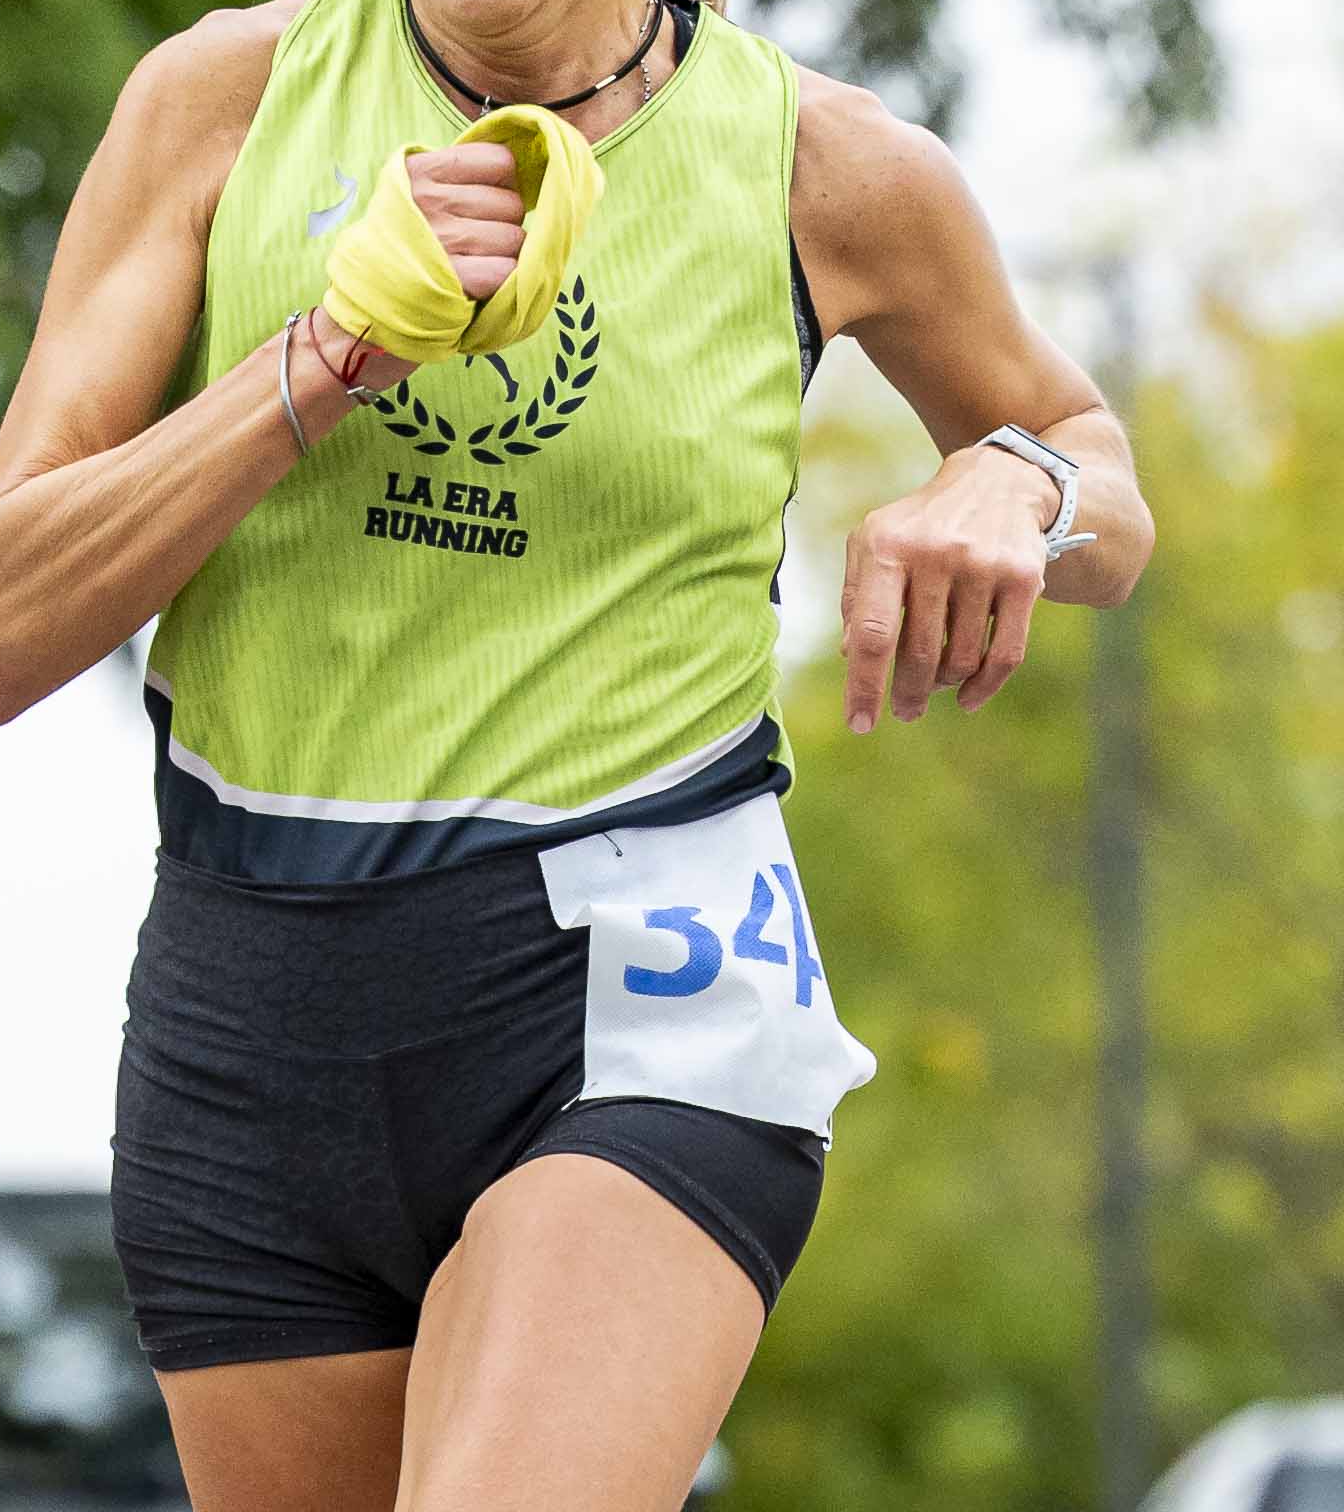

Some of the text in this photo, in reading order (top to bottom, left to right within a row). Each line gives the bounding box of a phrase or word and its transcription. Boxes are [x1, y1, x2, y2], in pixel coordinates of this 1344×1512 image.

[385, 472, 518, 521] LA ERA
[364, 506, 529, 558] RUNNING
